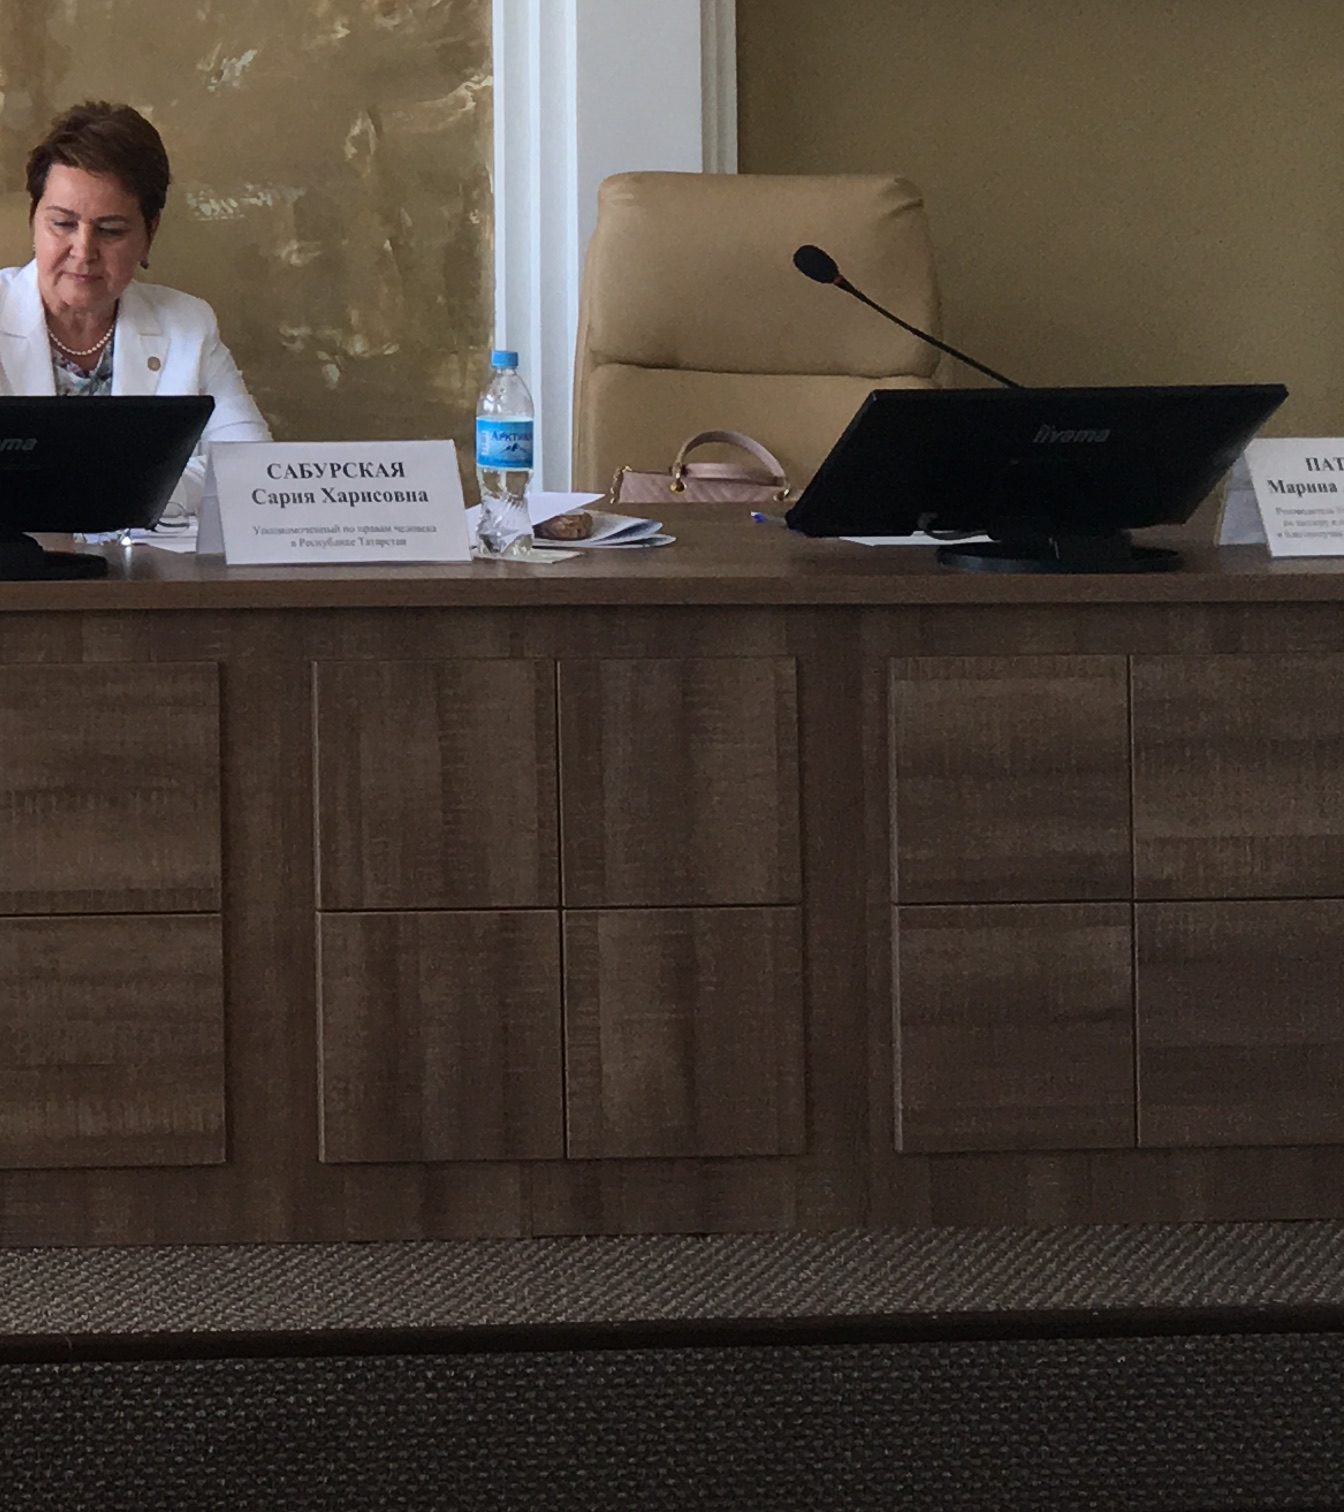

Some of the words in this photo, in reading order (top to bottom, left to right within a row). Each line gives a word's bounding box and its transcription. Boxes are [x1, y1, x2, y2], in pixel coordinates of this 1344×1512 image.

[267, 462, 405, 480] САБУРСКАЯ
[251, 487, 315, 509] Сария
[321, 487, 429, 508] Харисовна
[1267, 479, 1338, 498] Марина
